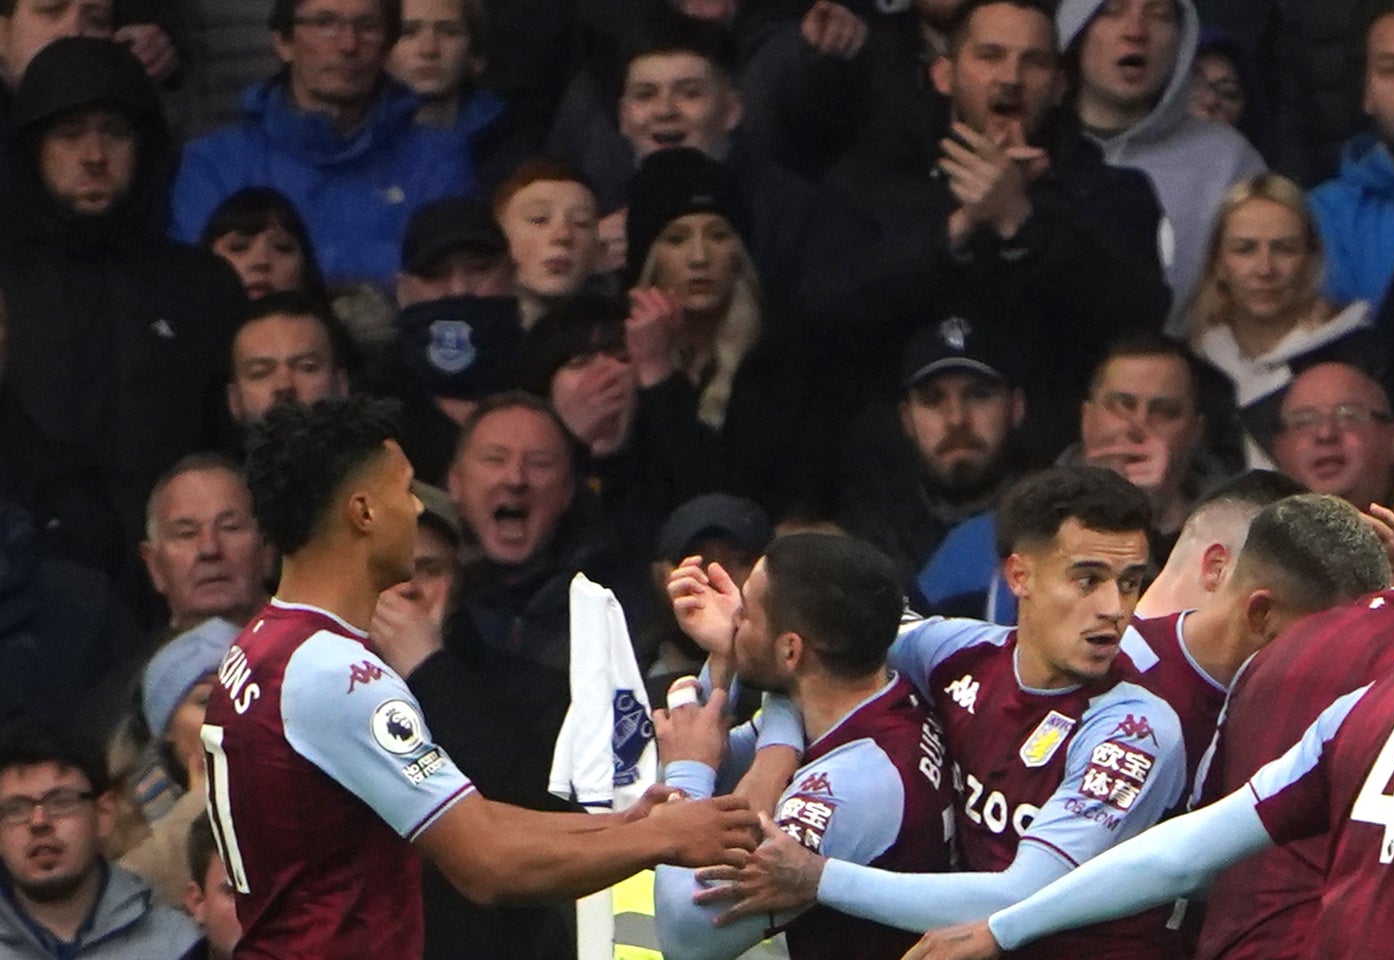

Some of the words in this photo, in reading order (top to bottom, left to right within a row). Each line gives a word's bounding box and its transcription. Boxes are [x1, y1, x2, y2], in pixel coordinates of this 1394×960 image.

[1090, 741, 1152, 783] 欧宝
[952, 760, 1043, 838] ZOO
[1082, 768, 1140, 808] 体育
[781, 797, 832, 830] 欧宝
